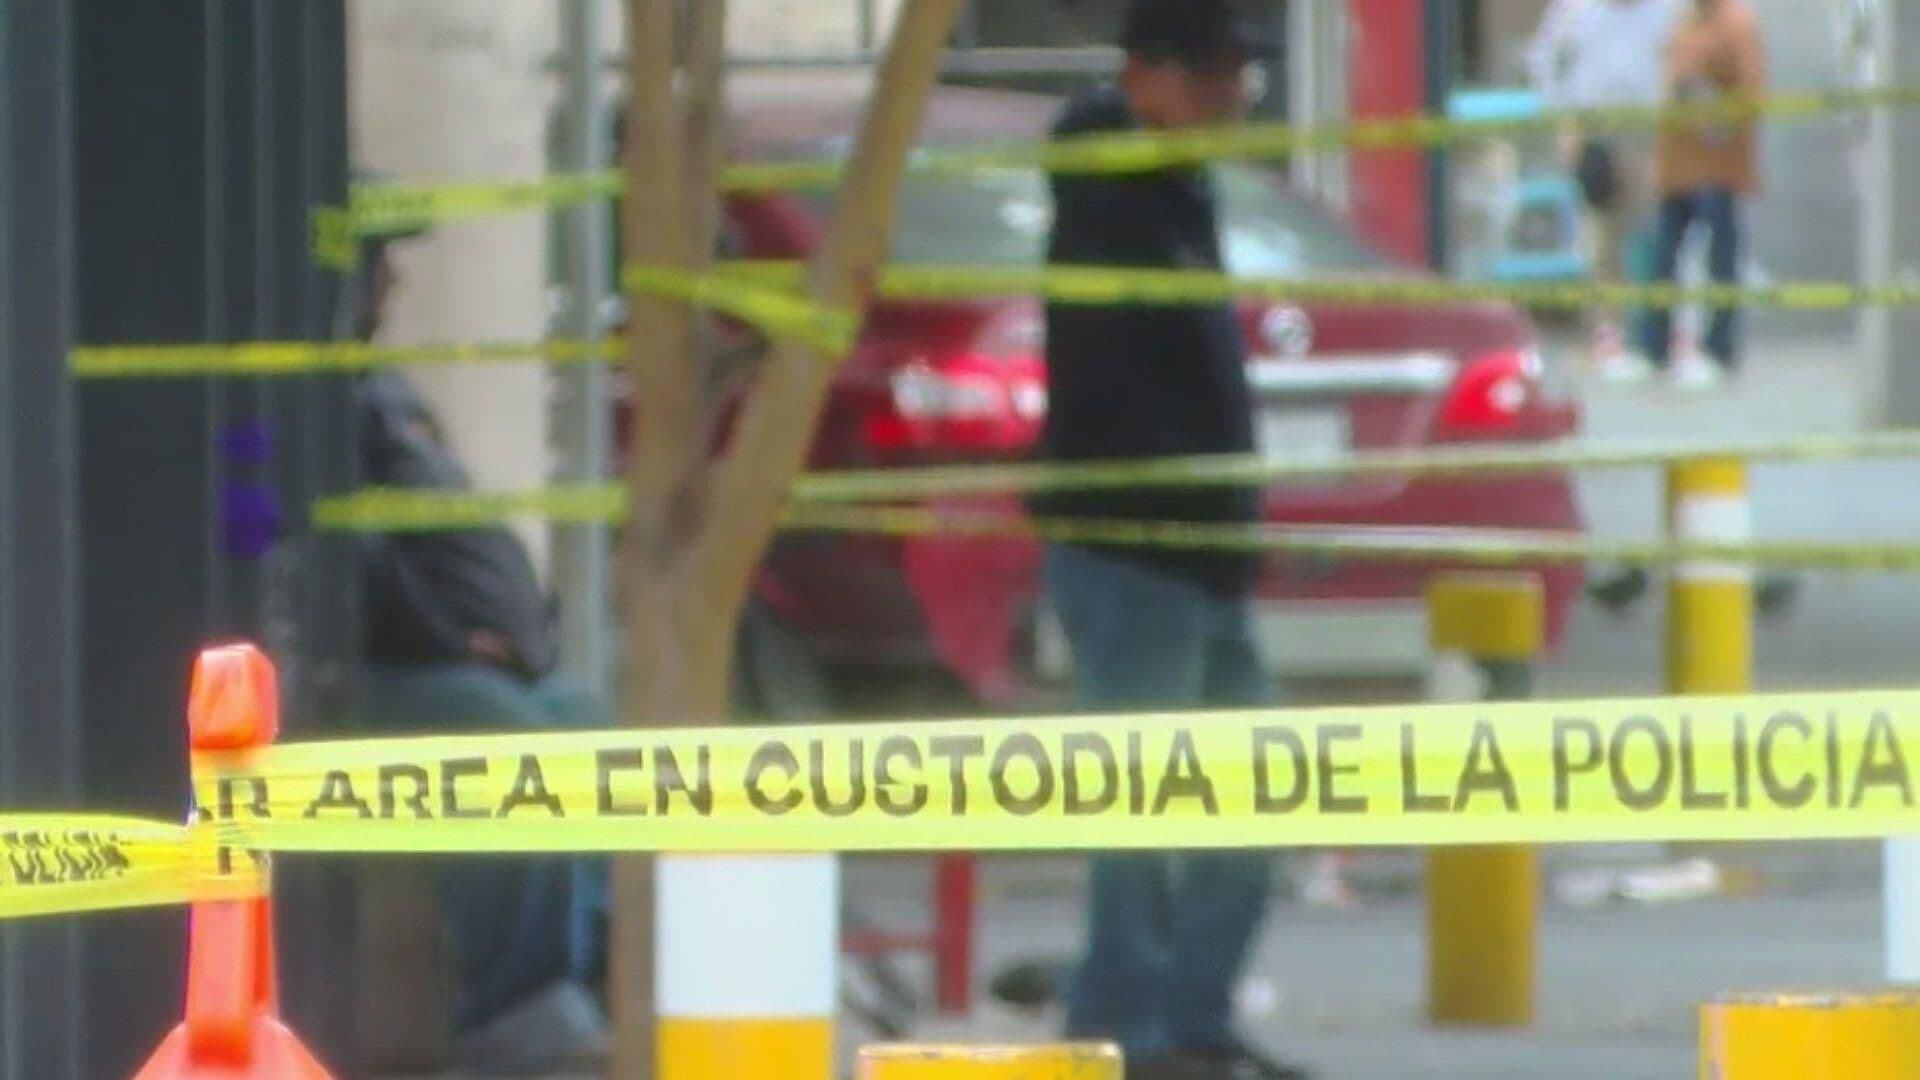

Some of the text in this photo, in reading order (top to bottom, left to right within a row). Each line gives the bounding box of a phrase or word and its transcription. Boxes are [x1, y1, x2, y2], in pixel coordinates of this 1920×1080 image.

[302, 753, 566, 819] AREA
[595, 744, 713, 817] EN
[743, 728, 1220, 818] CUSTODIA
[1251, 723, 1369, 814] DE
[1400, 718, 1520, 813] LA
[1552, 708, 1916, 813] POLICIA
